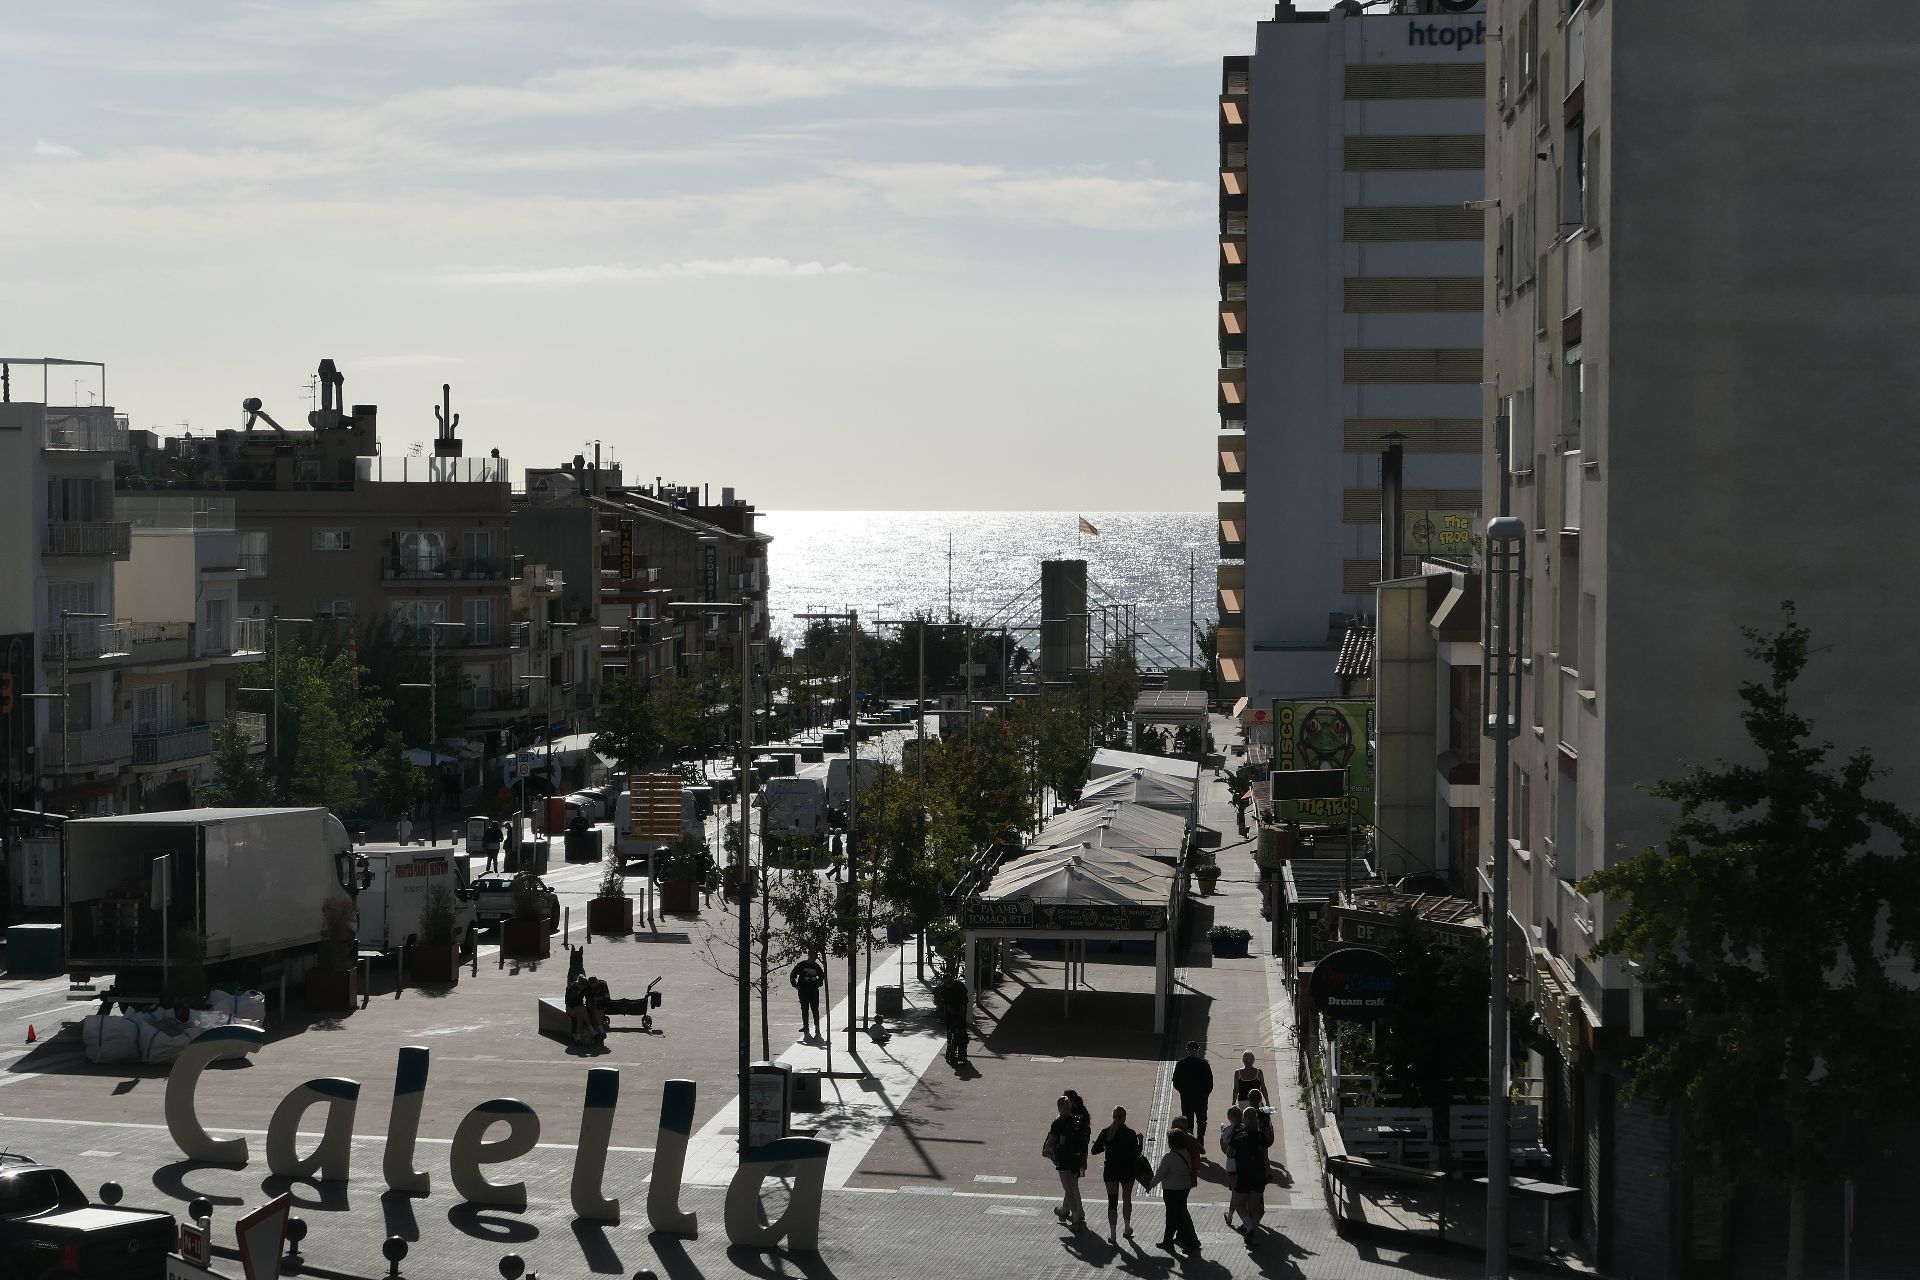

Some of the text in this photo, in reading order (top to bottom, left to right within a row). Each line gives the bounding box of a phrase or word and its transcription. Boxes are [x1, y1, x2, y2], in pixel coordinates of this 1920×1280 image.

[1280, 706, 1295, 770] DISCO
[1327, 996, 1363, 1006] Dream
[165, 1023, 831, 1251] Calella
